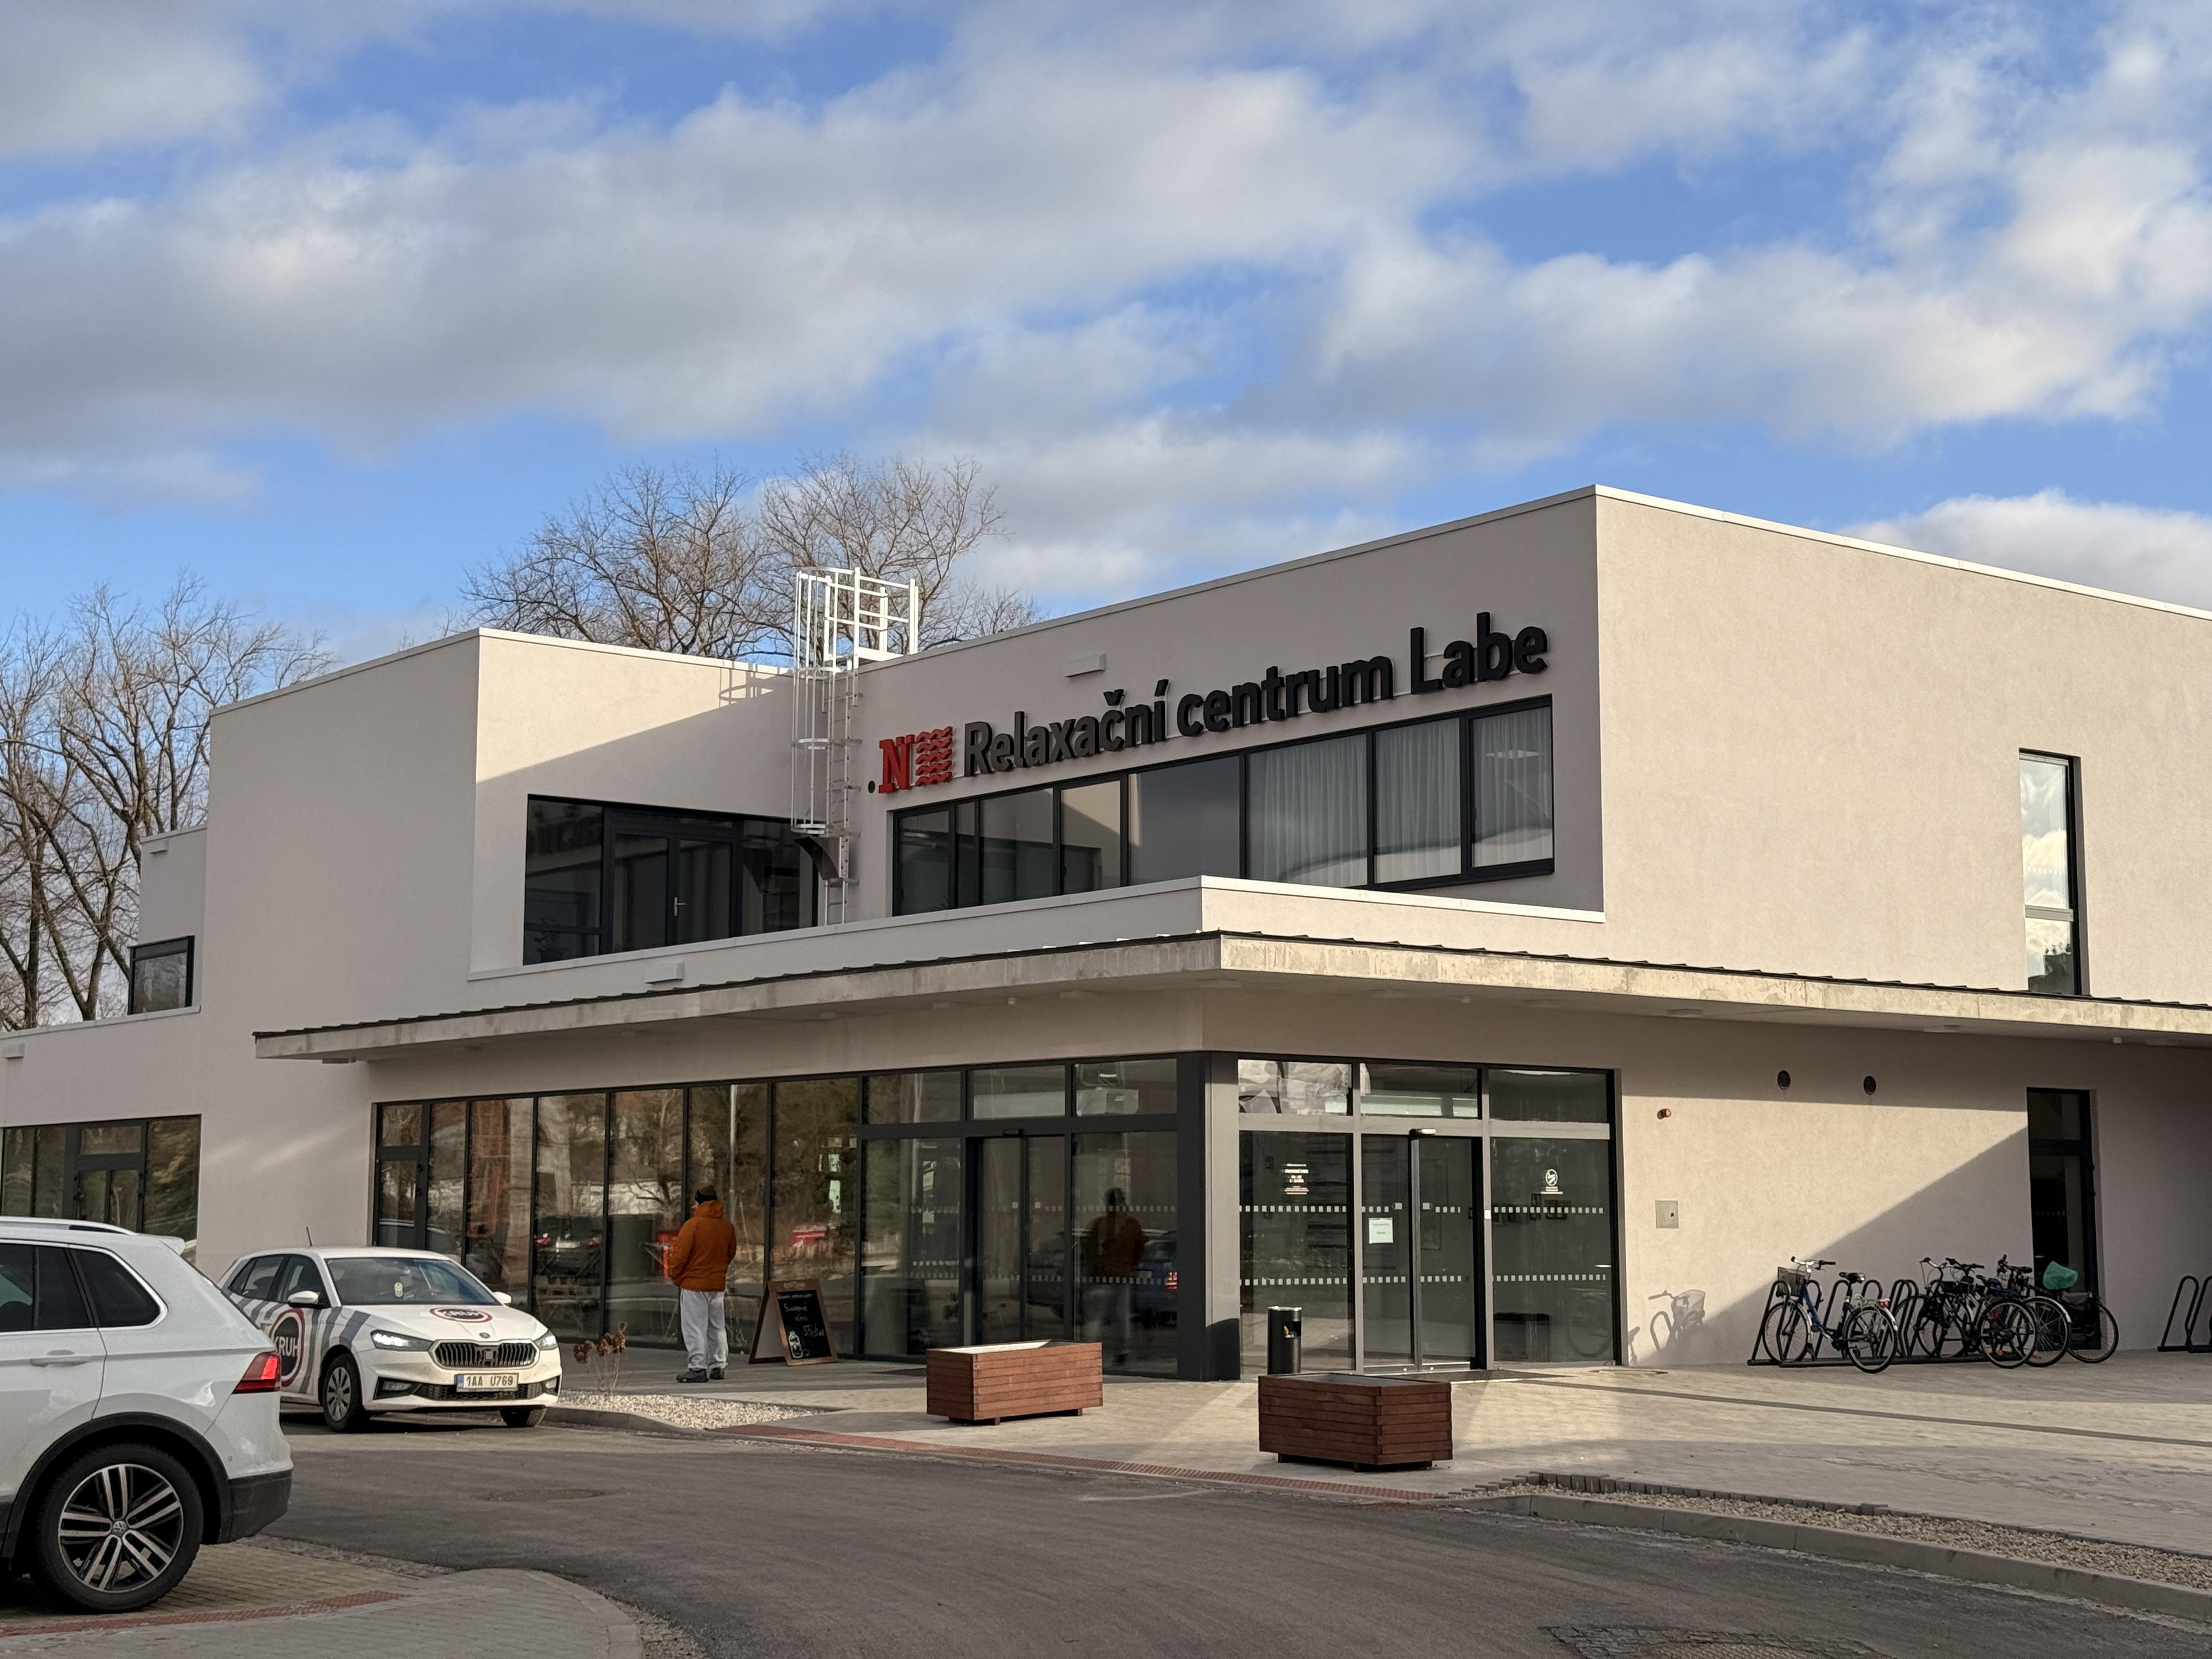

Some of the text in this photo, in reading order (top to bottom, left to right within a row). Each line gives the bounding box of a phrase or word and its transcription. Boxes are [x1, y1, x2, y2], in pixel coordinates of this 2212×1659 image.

[964, 679, 1169, 777] Relaxační
[1177, 655, 1394, 737] centrum
[1410, 611, 1548, 695] Labe
[466, 1376, 483, 1387] 1AA
